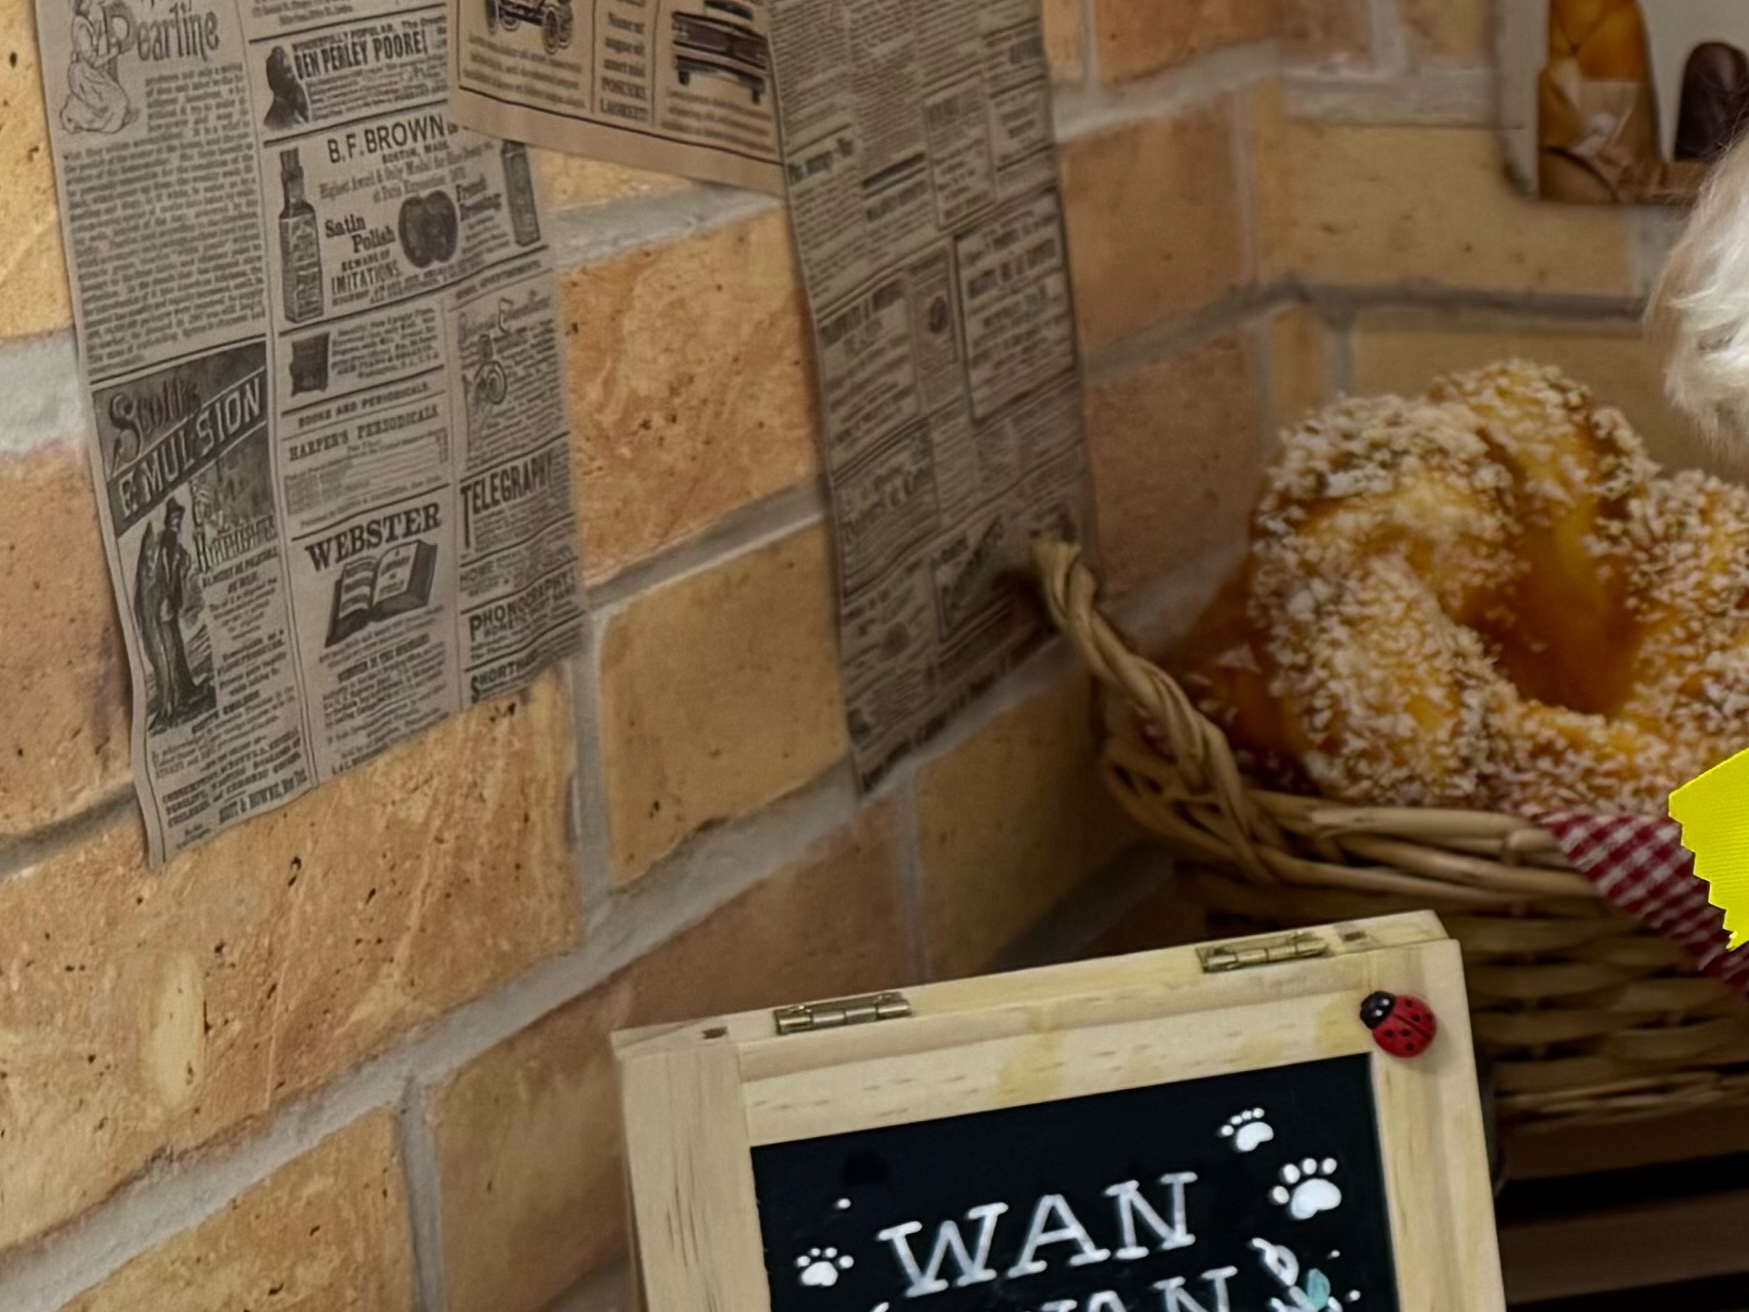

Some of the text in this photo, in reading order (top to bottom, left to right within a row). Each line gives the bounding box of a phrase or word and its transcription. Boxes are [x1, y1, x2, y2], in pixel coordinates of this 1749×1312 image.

[98, 1, 220, 63] Pearline
[324, 214, 367, 239] Satin
[117, 377, 262, 518] EMULSION
[304, 501, 443, 572] WEBSTER
[876, 1171, 1199, 1298] WAN
